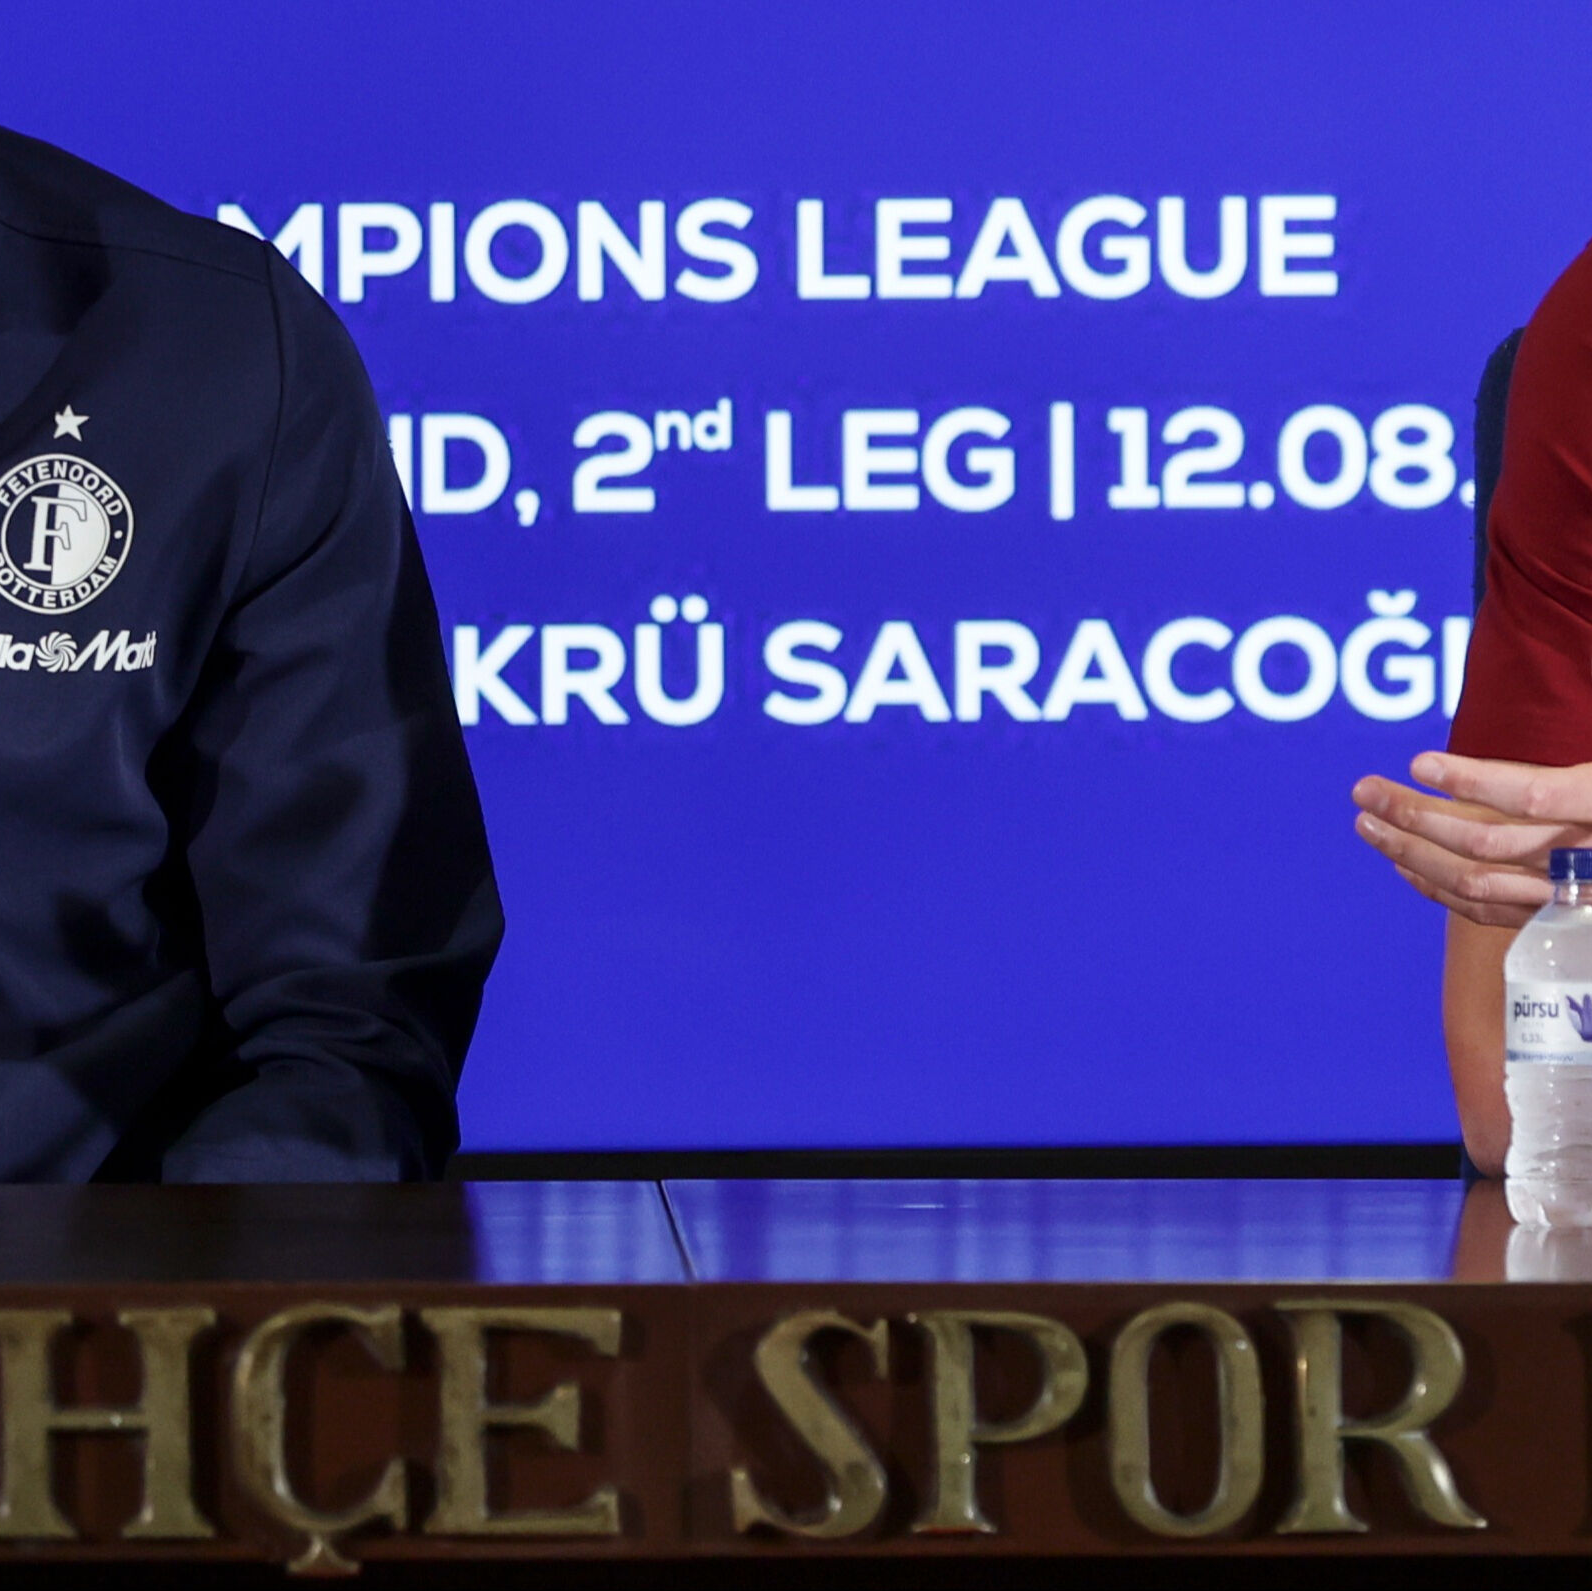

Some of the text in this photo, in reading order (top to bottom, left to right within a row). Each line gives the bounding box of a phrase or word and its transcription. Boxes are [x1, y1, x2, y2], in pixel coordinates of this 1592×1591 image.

[796, 194, 1339, 300] LEAGUE
[571, 396, 732, 513] 2nd
[764, 406, 1016, 513] LEG
[1513, 994, 1559, 1023] pürsu
[729, 1300, 1488, 1541] SPOR
